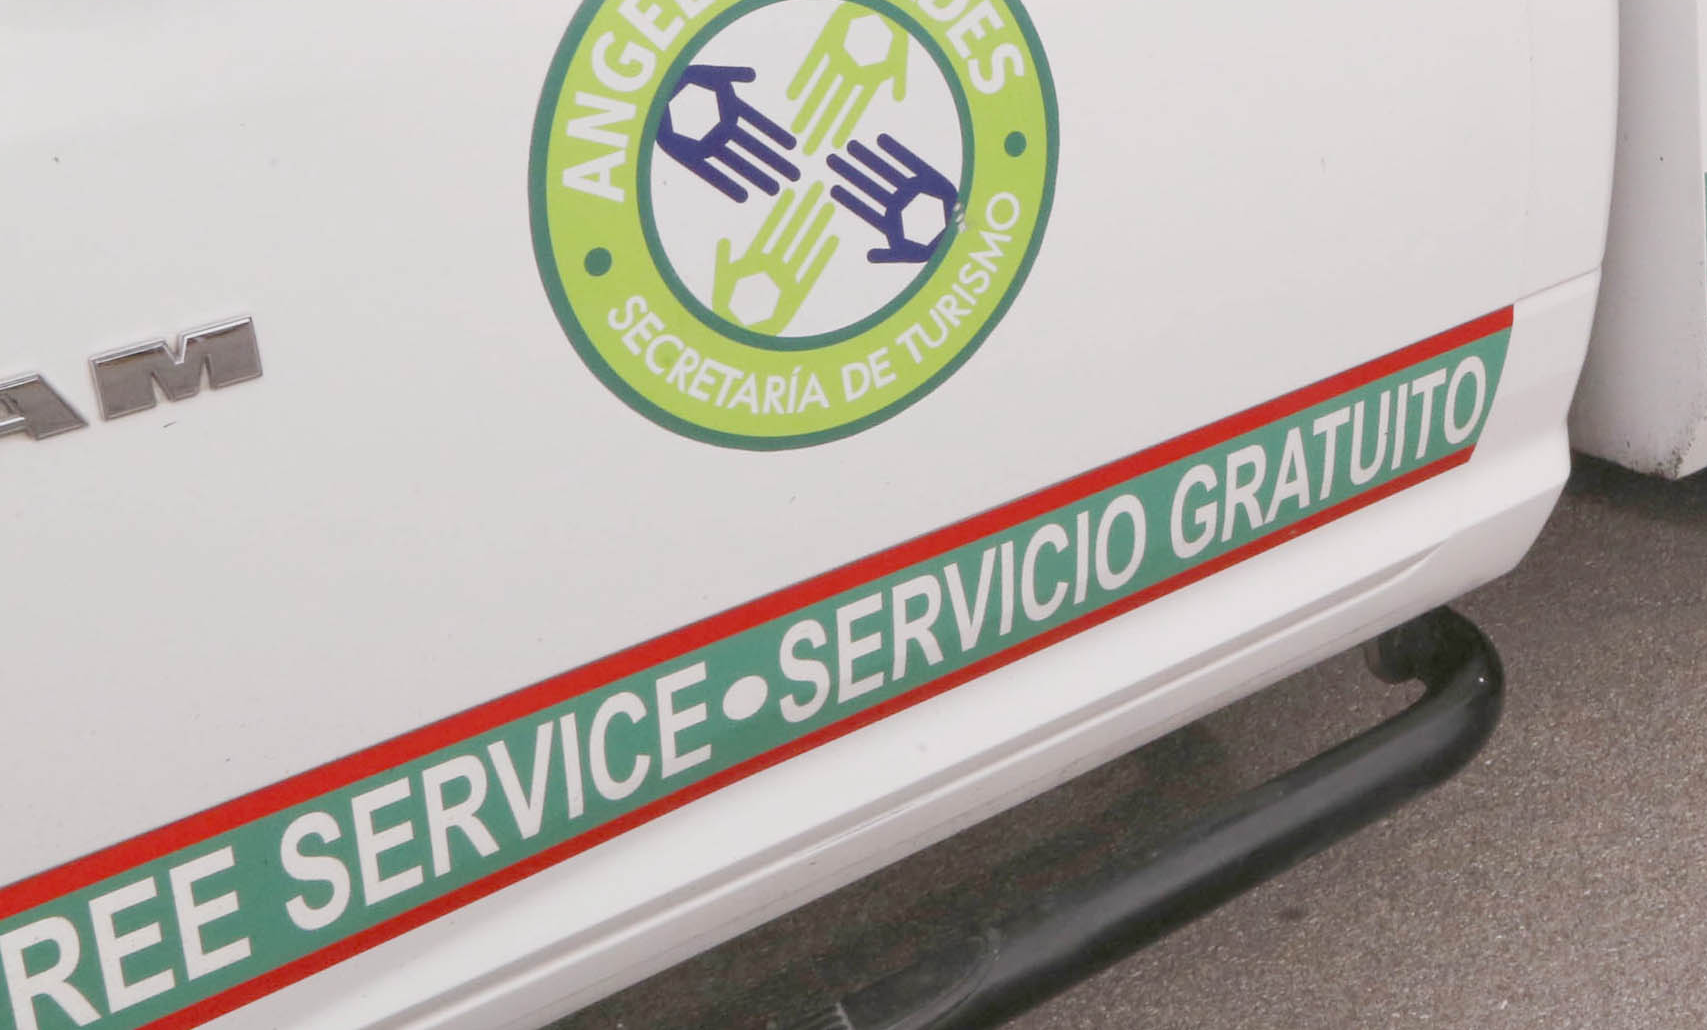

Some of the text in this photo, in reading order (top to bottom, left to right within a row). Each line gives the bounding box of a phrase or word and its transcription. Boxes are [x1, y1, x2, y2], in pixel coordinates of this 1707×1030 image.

[608, 191, 1021, 414] SECRETARÍA DE TURISMO
[0, 356, 1488, 1030] REE SERVICE SERVICIO GRATUITO
